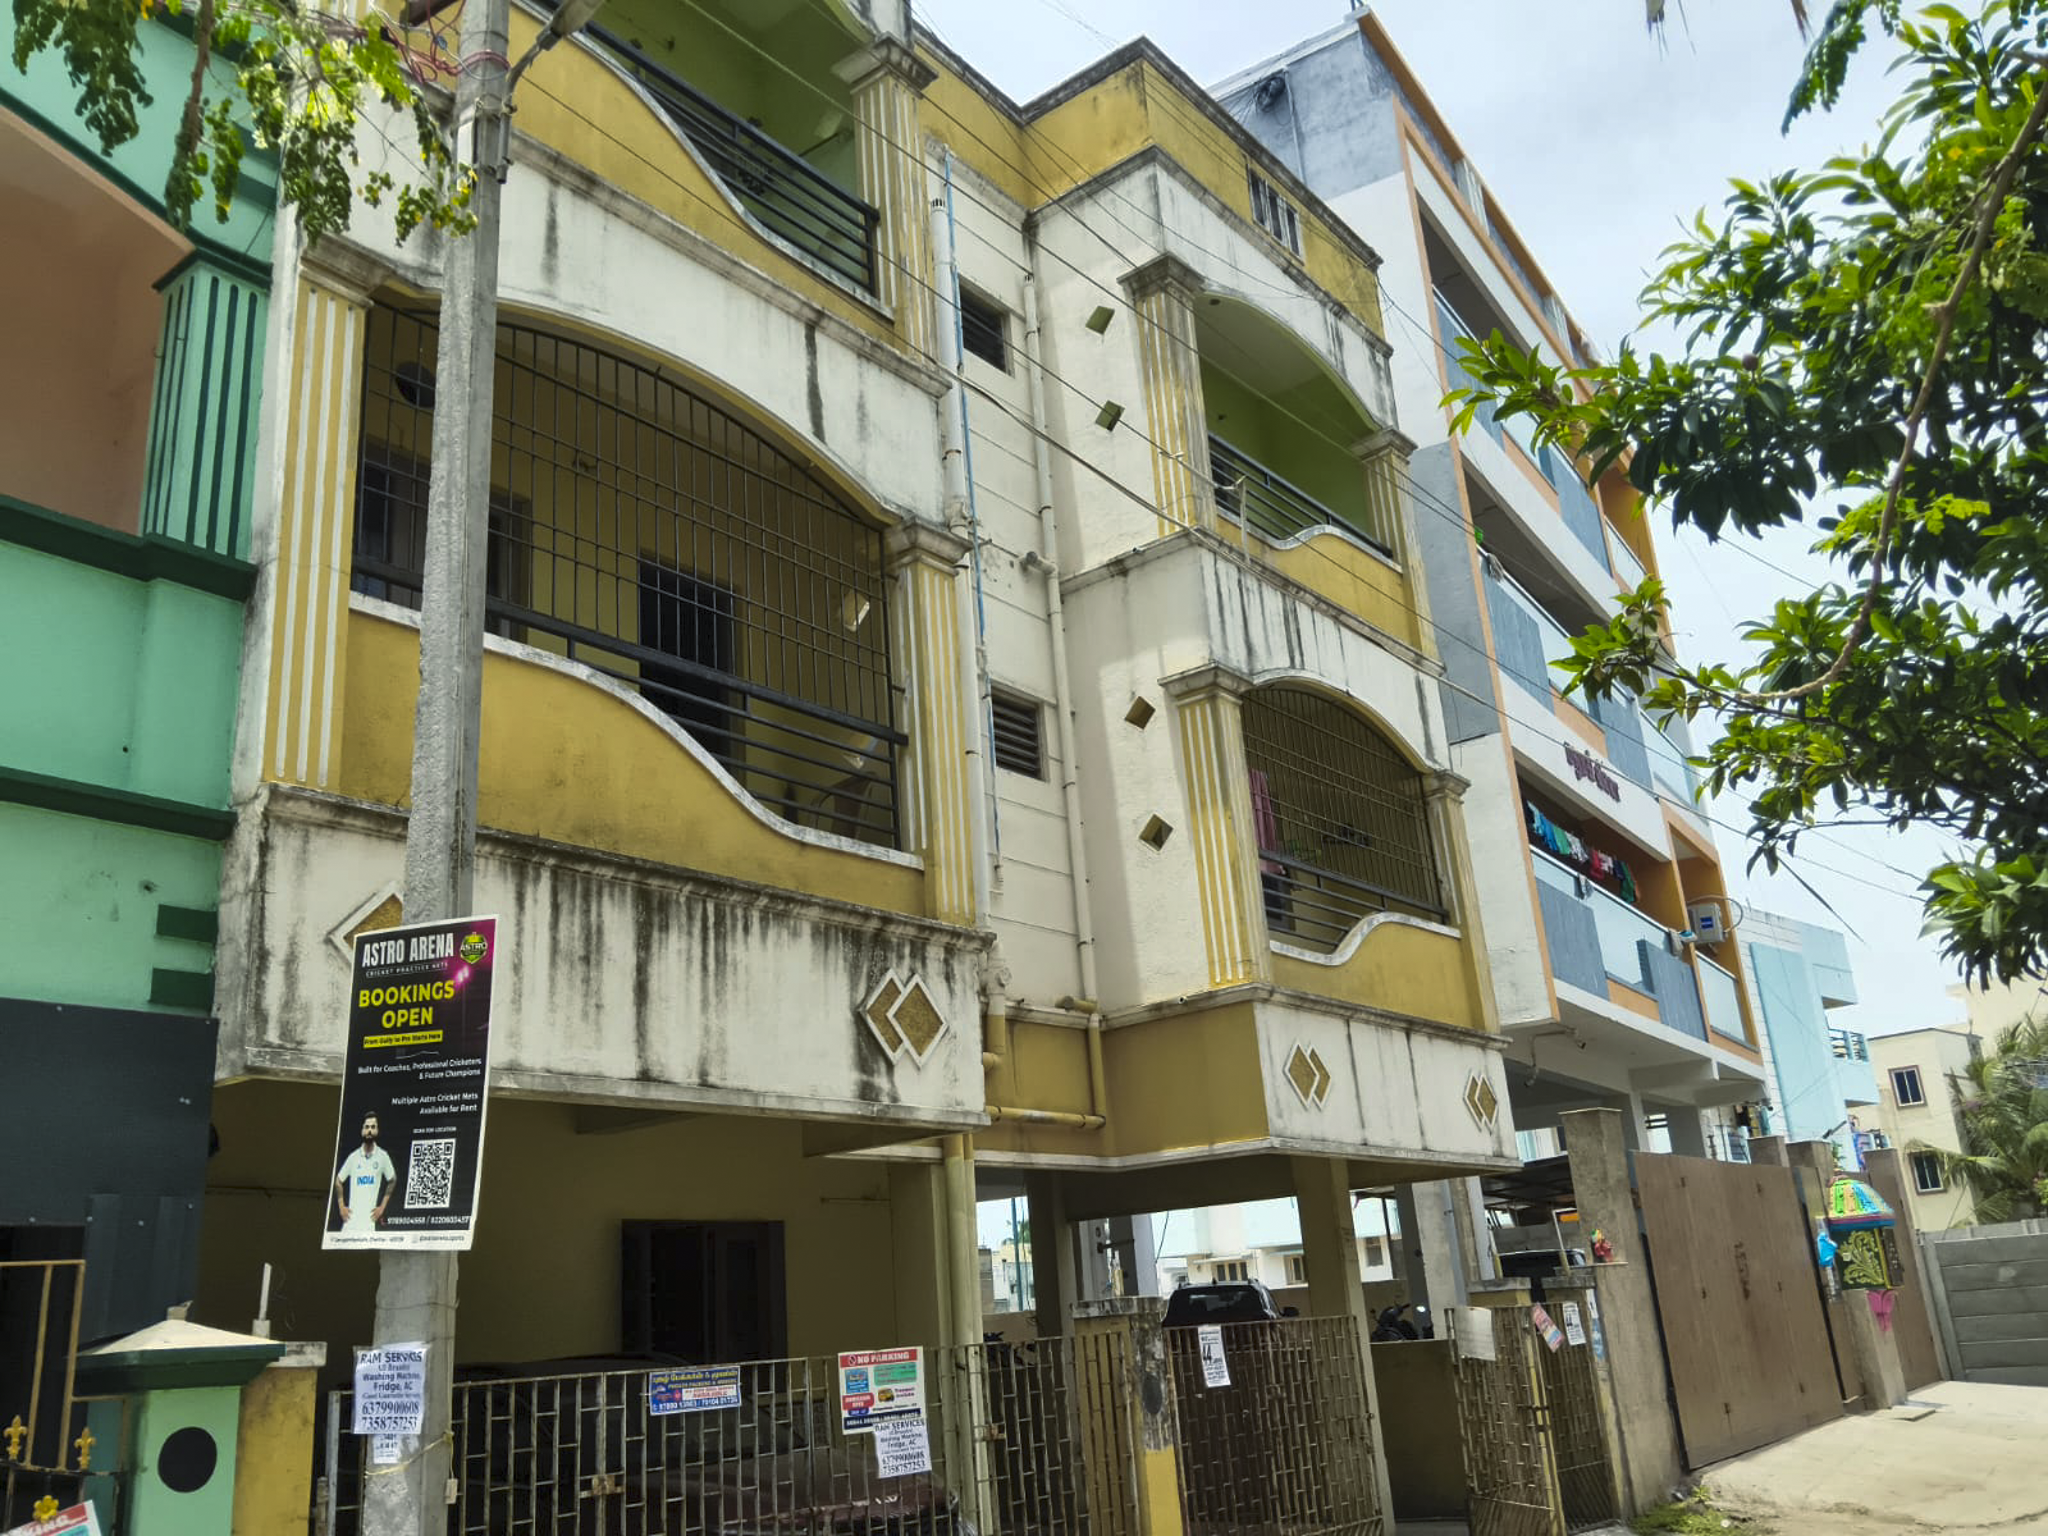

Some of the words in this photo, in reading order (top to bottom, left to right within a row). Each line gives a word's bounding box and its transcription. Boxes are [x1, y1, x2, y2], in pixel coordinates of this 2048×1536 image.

[362, 939, 405, 968] ASTRO
[409, 932, 454, 962] ARENA
[358, 980, 455, 1007] BOOKINGS
[382, 1006, 433, 1028] OPEN
[357, 1175, 375, 1186] INDIA
[360, 1353, 382, 1364] RAM
[857, 1355, 870, 1363] NO
[871, 1352, 910, 1363] PARKING
[363, 1373, 395, 1382] Washing
[404, 1381, 413, 1391] AC
